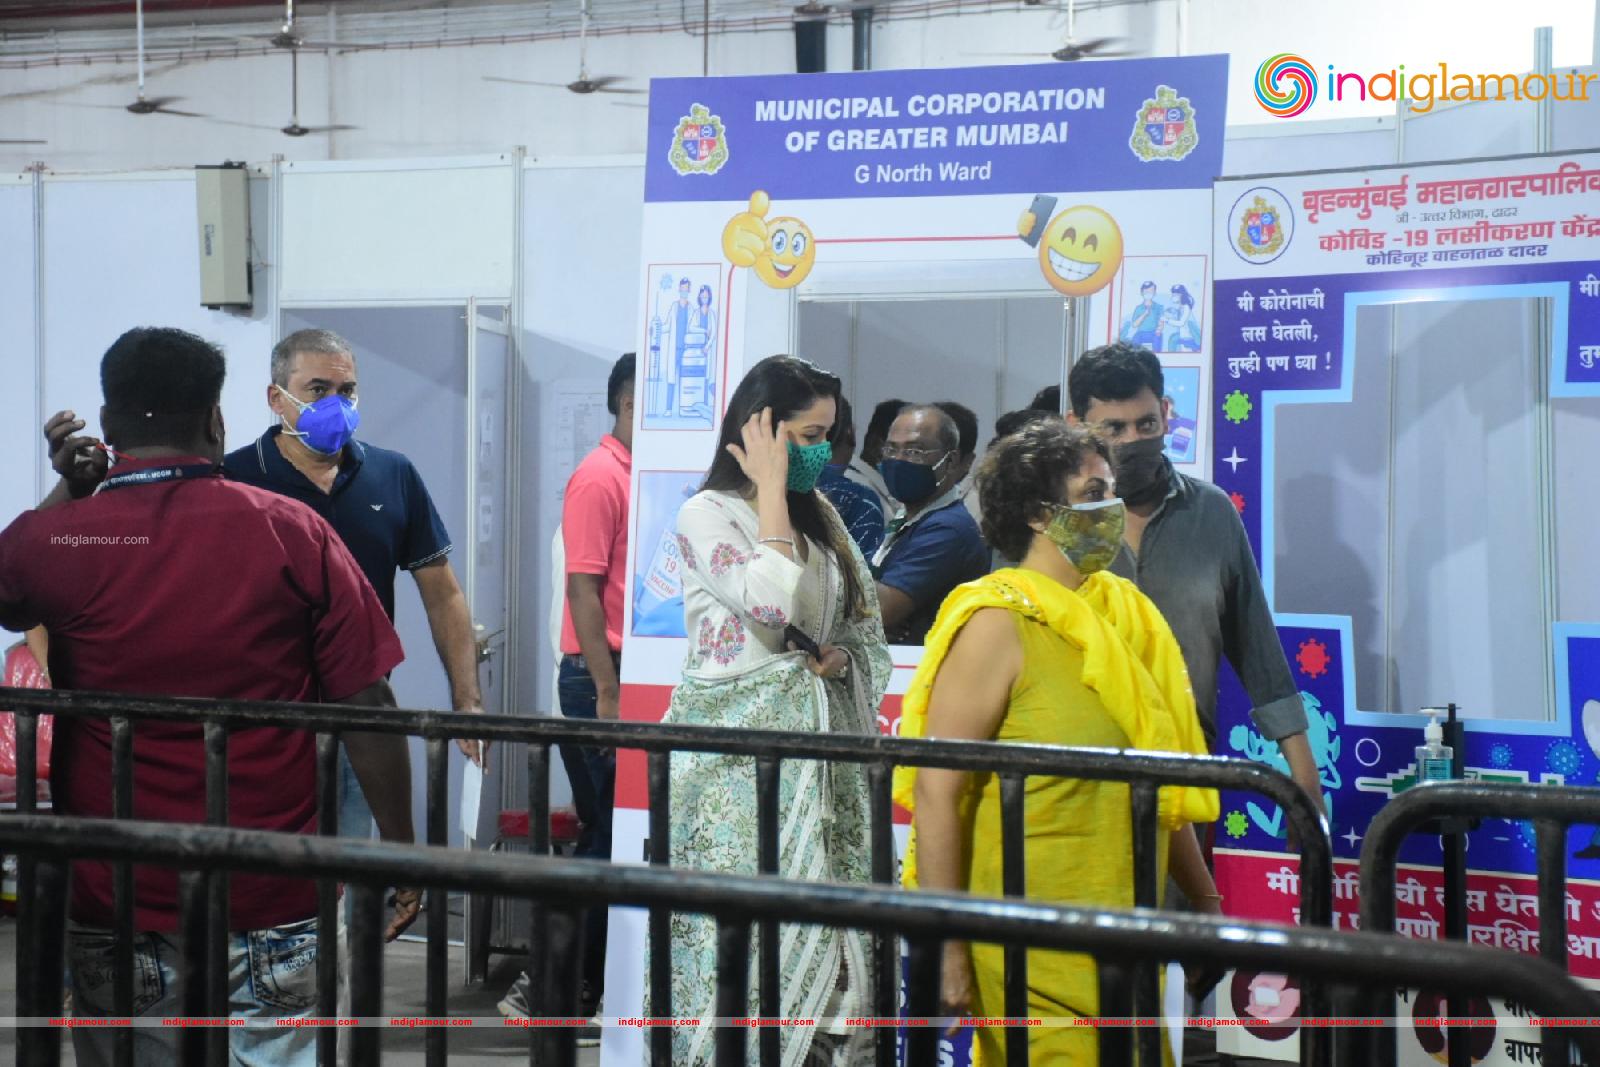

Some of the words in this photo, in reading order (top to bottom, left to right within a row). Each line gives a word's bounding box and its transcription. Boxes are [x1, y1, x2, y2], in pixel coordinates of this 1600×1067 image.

[755, 97, 899, 122] MUNICIPAL
[907, 87, 1105, 117] CORPORATION
[785, 131, 820, 153] OF
[827, 127, 948, 151] GREATER
[956, 121, 1068, 146] MUMBAI
[855, 165, 870, 183] G
[876, 163, 932, 182] North
[938, 160, 992, 181] Ward
[1303, 174, 1408, 224] बृहन्मुंबई
[1318, 228, 1387, 252] कोविड
[1435, 220, 1556, 246] लसीकरण
[1366, 249, 1428, 268] कोहिनूर
[1432, 246, 1504, 263] वाहनतळ
[1508, 244, 1548, 258] दादर
[1236, 290, 1255, 312] मी
[1259, 287, 1325, 311] कोरोनाची
[1241, 326, 1268, 343] लस
[1271, 318, 1319, 342] घेतली,
[1227, 350, 1260, 379] तुम्ही
[1265, 355, 1290, 371] पण
[1265, 866, 1300, 895] मी
